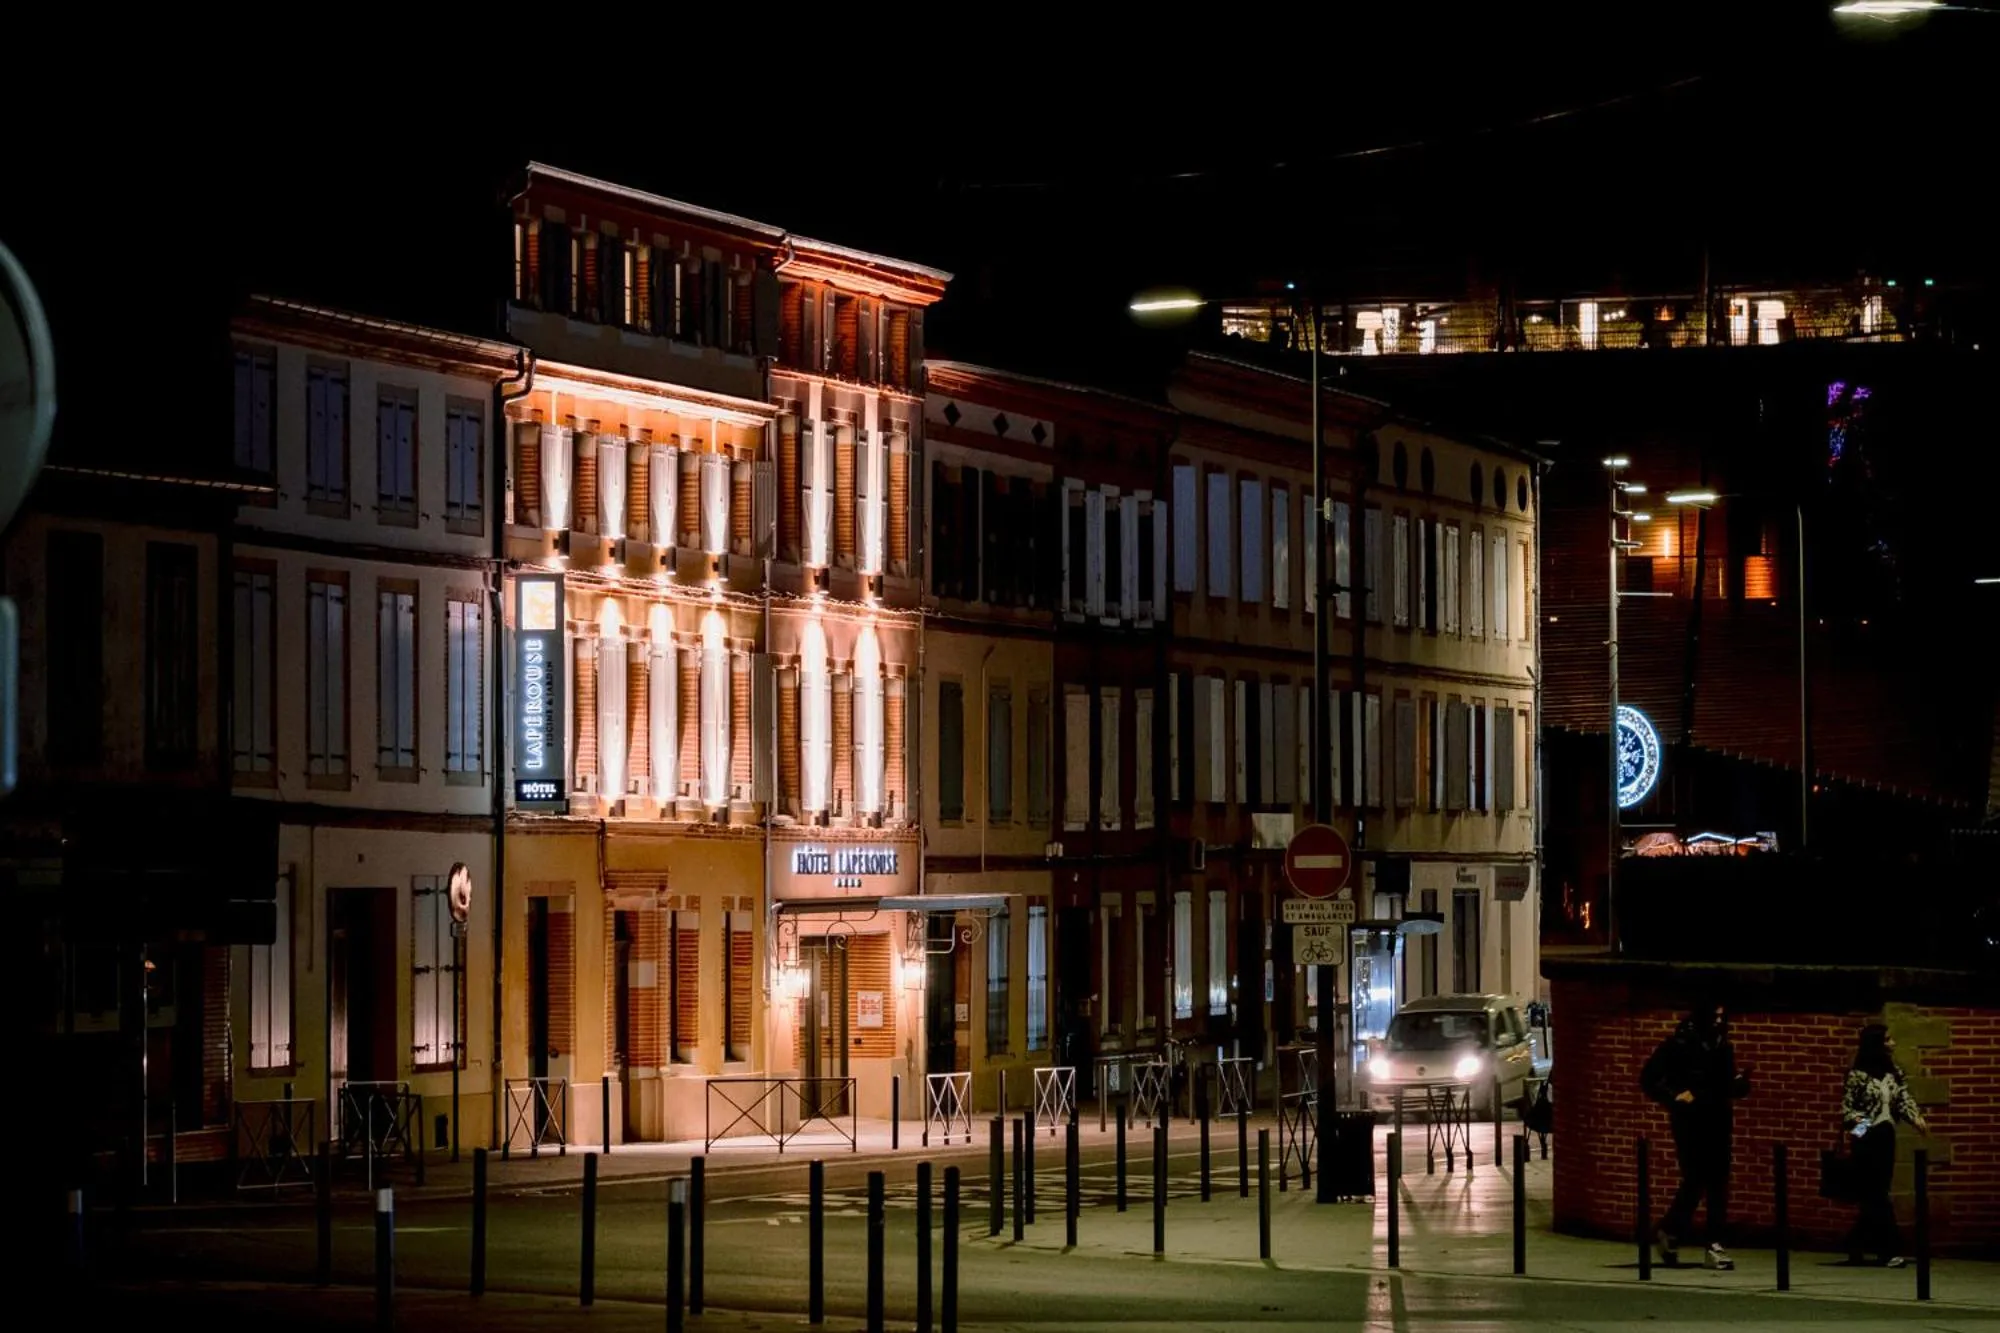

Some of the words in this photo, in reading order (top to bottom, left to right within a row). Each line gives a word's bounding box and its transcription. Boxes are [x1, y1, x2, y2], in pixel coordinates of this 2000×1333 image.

[524, 638, 543, 770] LAPÉROUSE
[522, 781, 557, 793] HÔTEL
[794, 847, 833, 876] HÔTEL
[838, 848, 898, 876] LAPÉROUSE
[1304, 926, 1331, 937] SAUF
